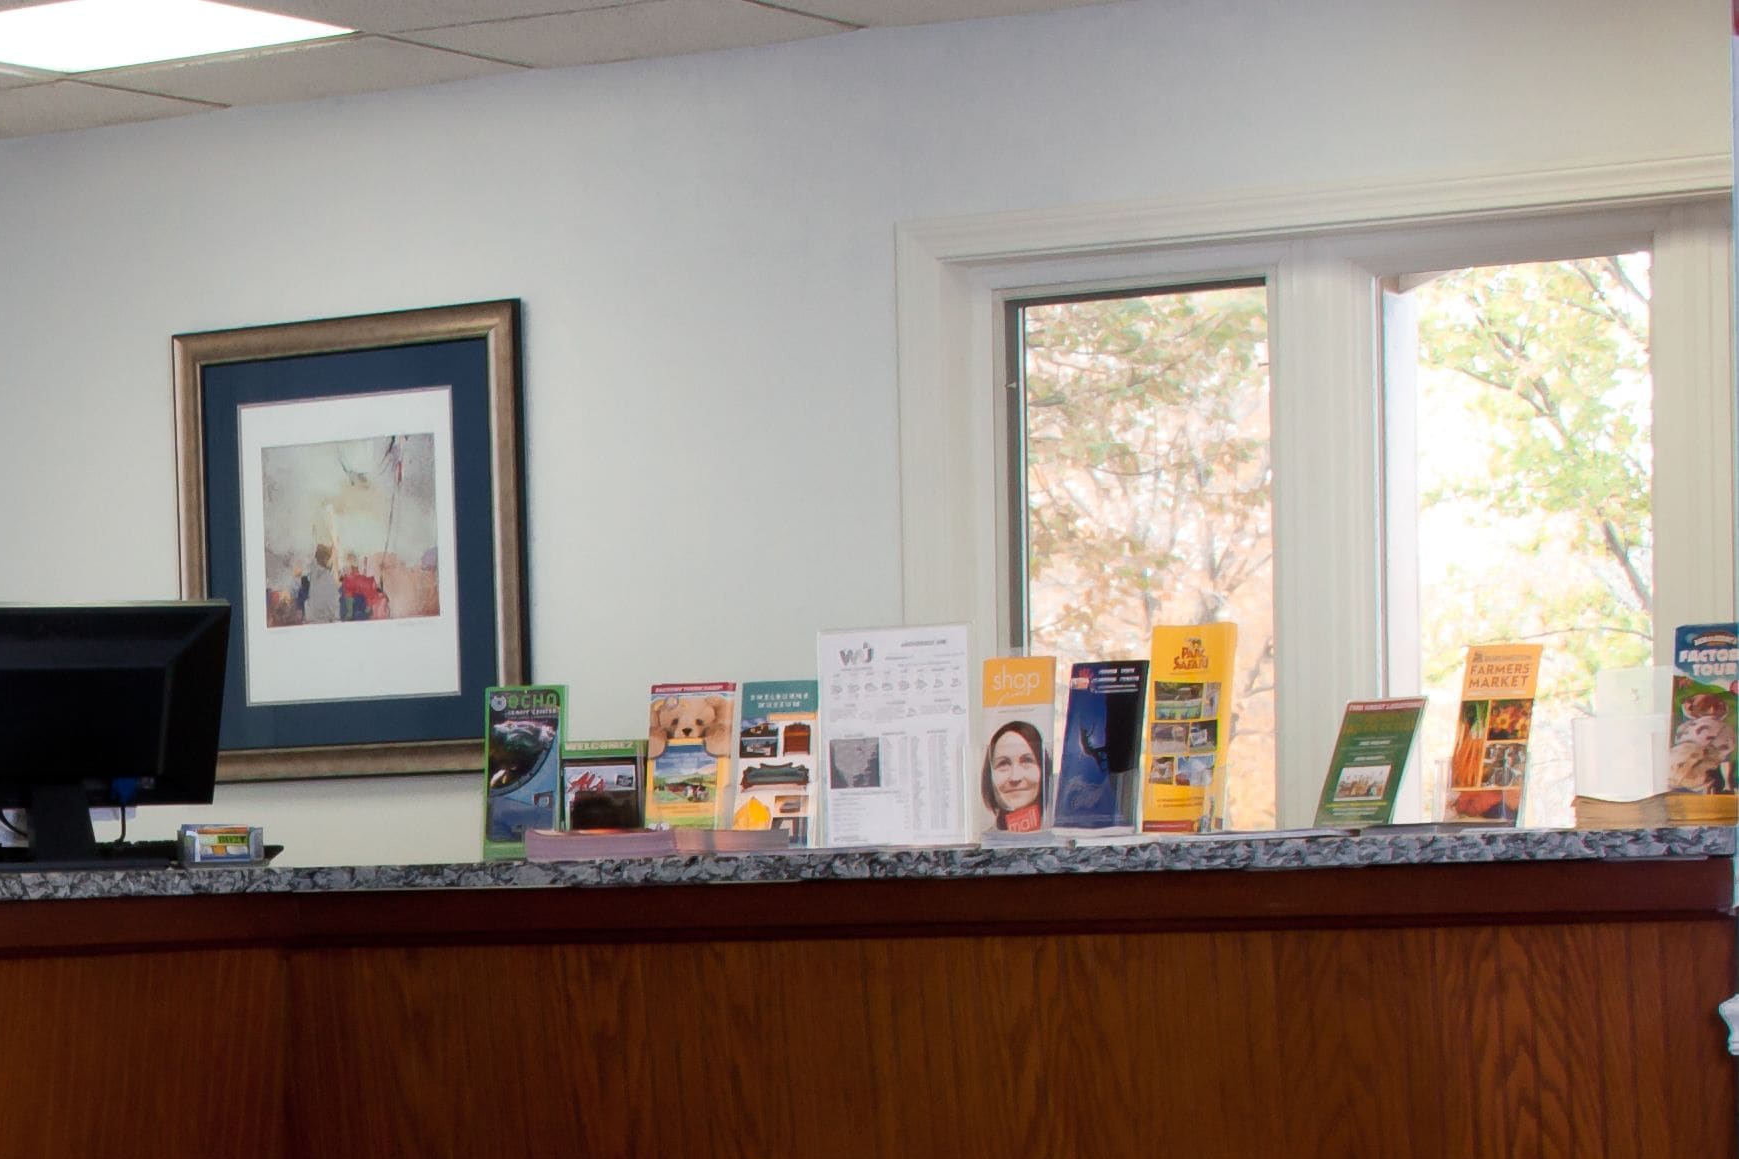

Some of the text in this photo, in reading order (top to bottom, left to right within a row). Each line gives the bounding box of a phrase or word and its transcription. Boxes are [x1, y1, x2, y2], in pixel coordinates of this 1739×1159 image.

[1470, 663, 1530, 675] FARMERS
[993, 664, 1040, 696] shop
[1468, 675, 1529, 688] MARKET
[1009, 809, 1038, 831] mall
